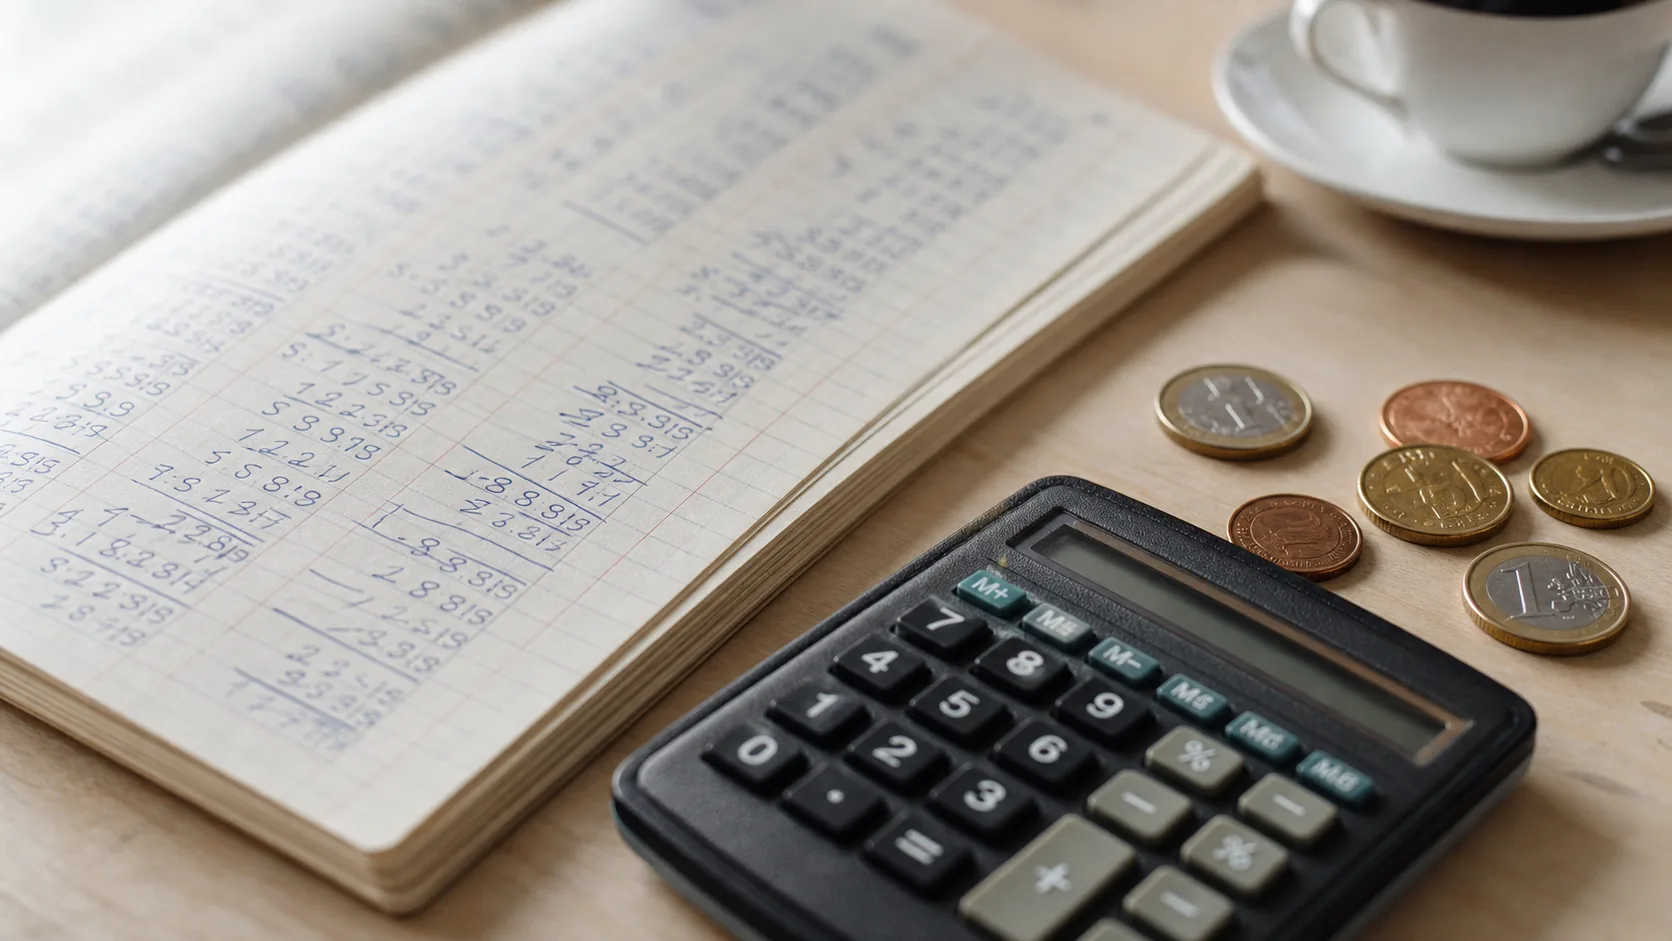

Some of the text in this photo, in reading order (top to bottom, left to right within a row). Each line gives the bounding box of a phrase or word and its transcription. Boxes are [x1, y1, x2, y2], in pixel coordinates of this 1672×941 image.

[971, 576, 1009, 600] M+
[926, 606, 966, 631] 7
[861, 650, 899, 674] 4
[1005, 650, 1044, 677] 8
[806, 691, 840, 718] 1
[938, 689, 980, 718] 5
[1085, 692, 1125, 719] 9
[737, 735, 778, 766] 0
[872, 735, 918, 768] 2
[1027, 734, 1068, 764] 6
[963, 779, 1008, 812] 3
